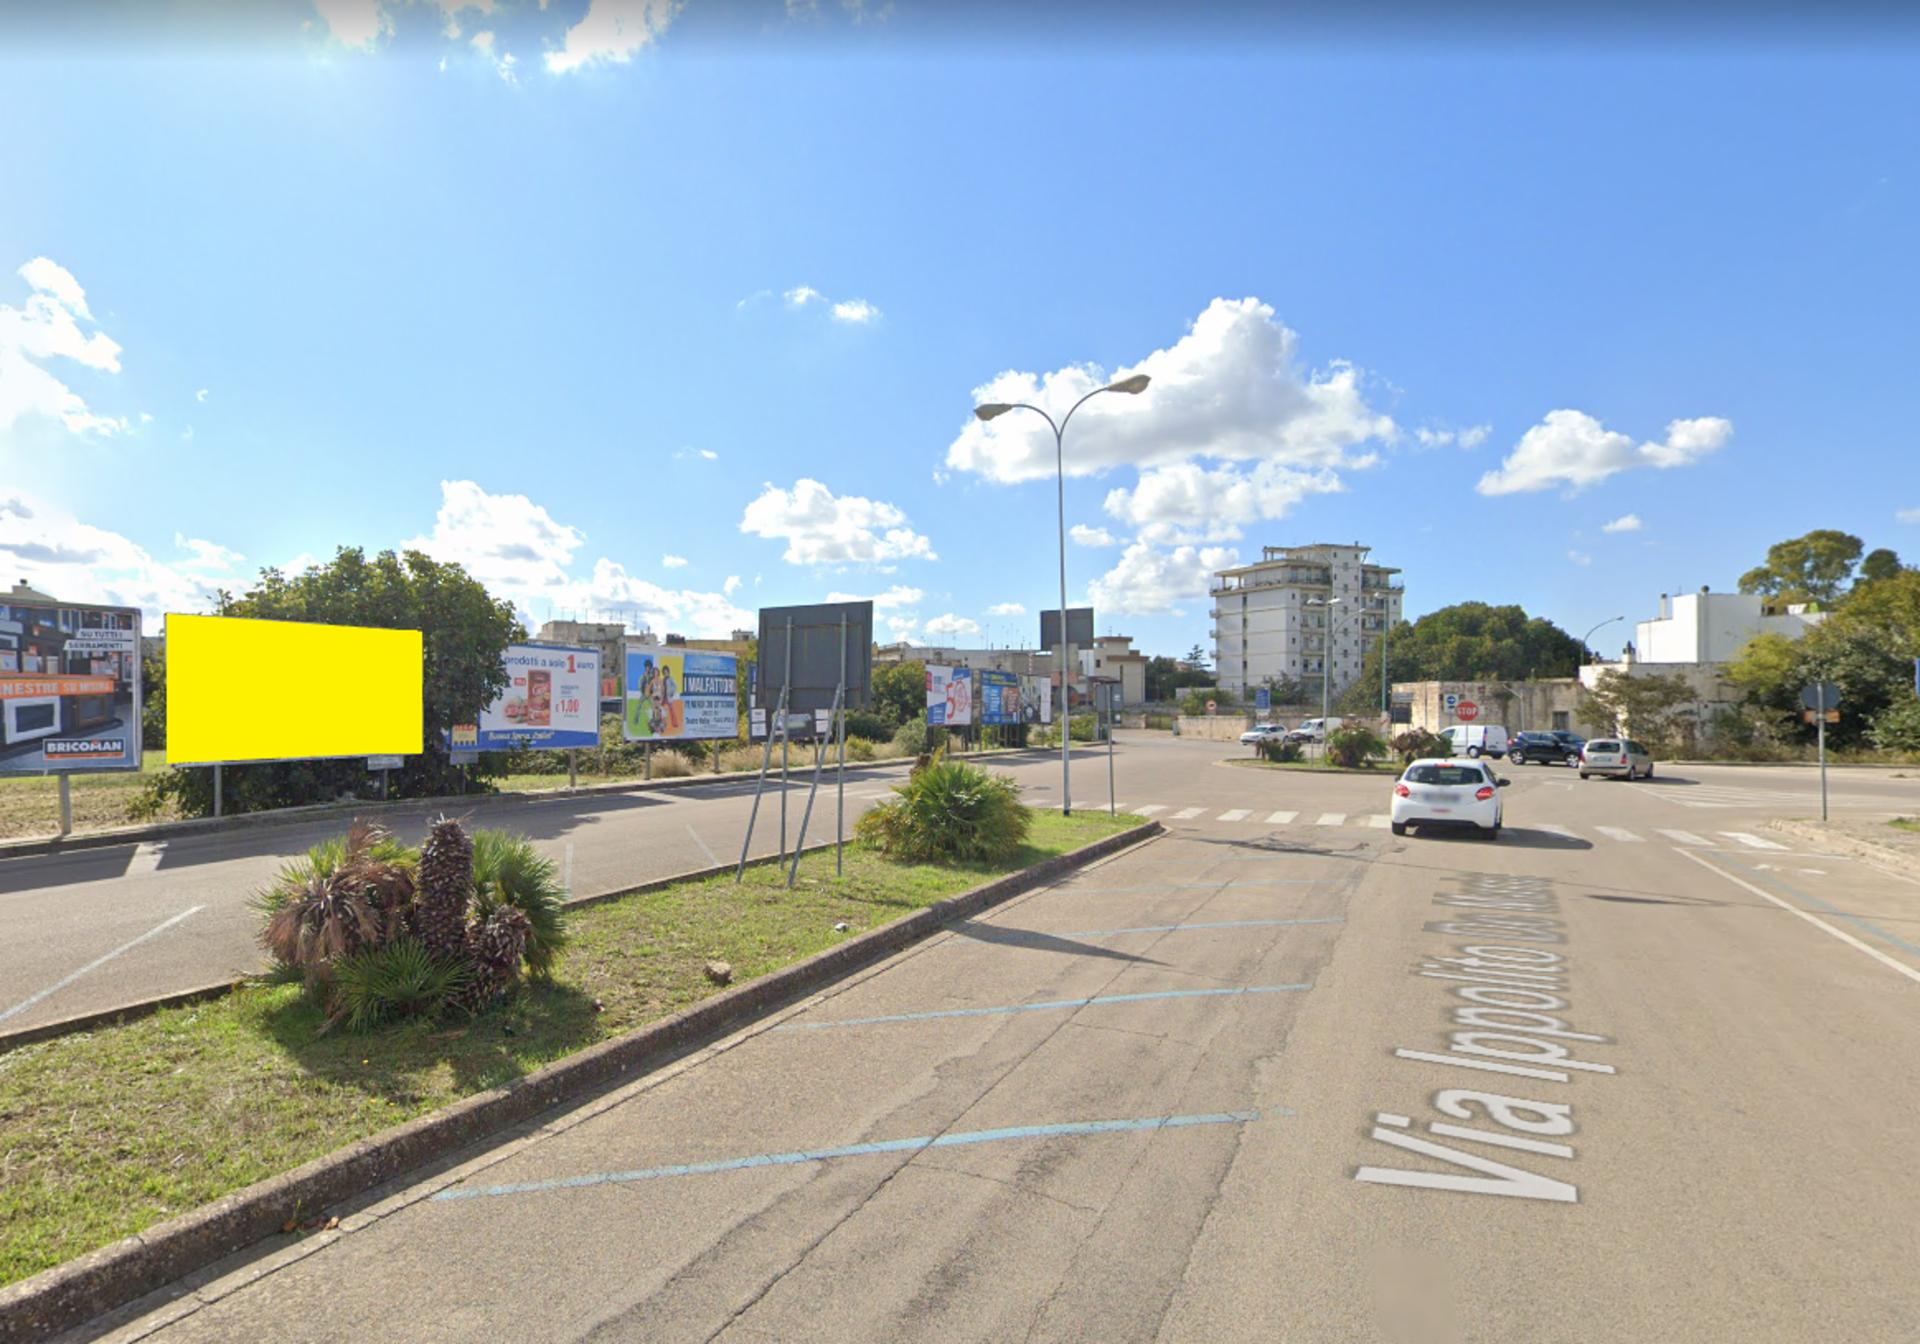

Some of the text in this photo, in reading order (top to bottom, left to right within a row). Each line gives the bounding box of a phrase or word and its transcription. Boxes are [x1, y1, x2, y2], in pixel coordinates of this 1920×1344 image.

[567, 654, 577, 673] 1
[1457, 707, 1477, 715] STOP
[47, 739, 122, 753] BRICOMAN
